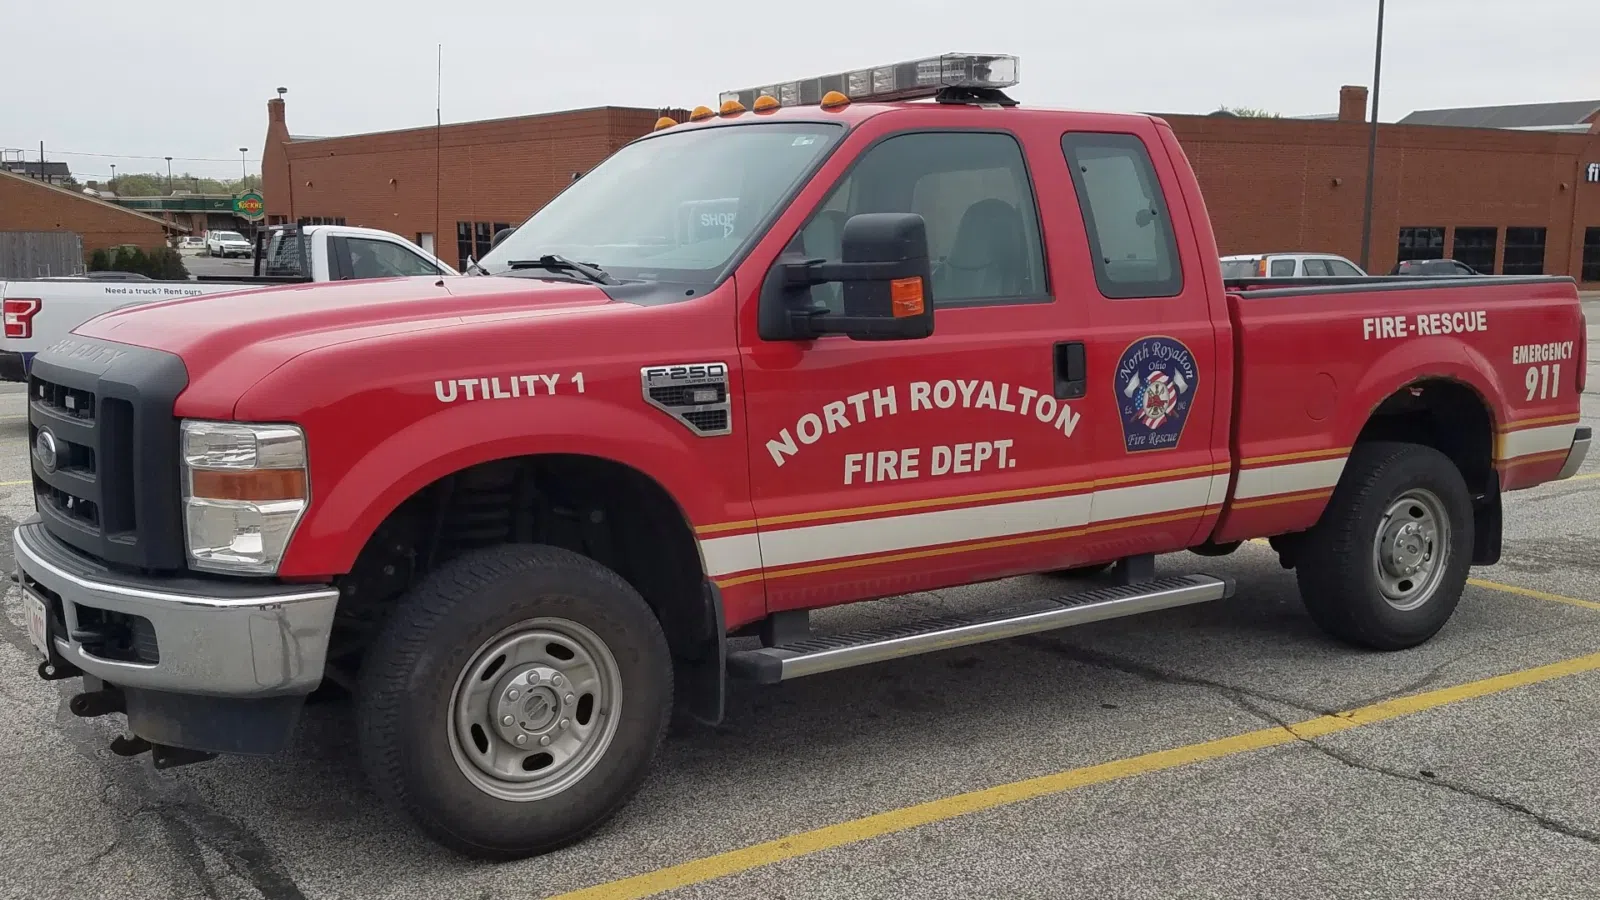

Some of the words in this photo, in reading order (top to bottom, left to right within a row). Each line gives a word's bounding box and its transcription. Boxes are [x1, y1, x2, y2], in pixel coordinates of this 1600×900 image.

[1587, 163, 1600, 182] fi
[1120, 341, 1149, 383] North
[1152, 341, 1194, 379] Royalton
[1148, 360, 1166, 371] Ohio
[1512, 341, 1573, 364] EMERGENCY
[647, 365, 724, 382] F-250
[1525, 364, 1561, 401] 911
[434, 372, 560, 403] UTILITY
[571, 372, 585, 394] 1
[765, 385, 897, 467] NORTH
[910, 379, 1081, 438] ROYALTON
[1128, 433, 1146, 445] Fire
[1148, 432, 1178, 446] Rescue
[843, 448, 920, 485] FIRE
[930, 439, 1016, 477] DEPT.
